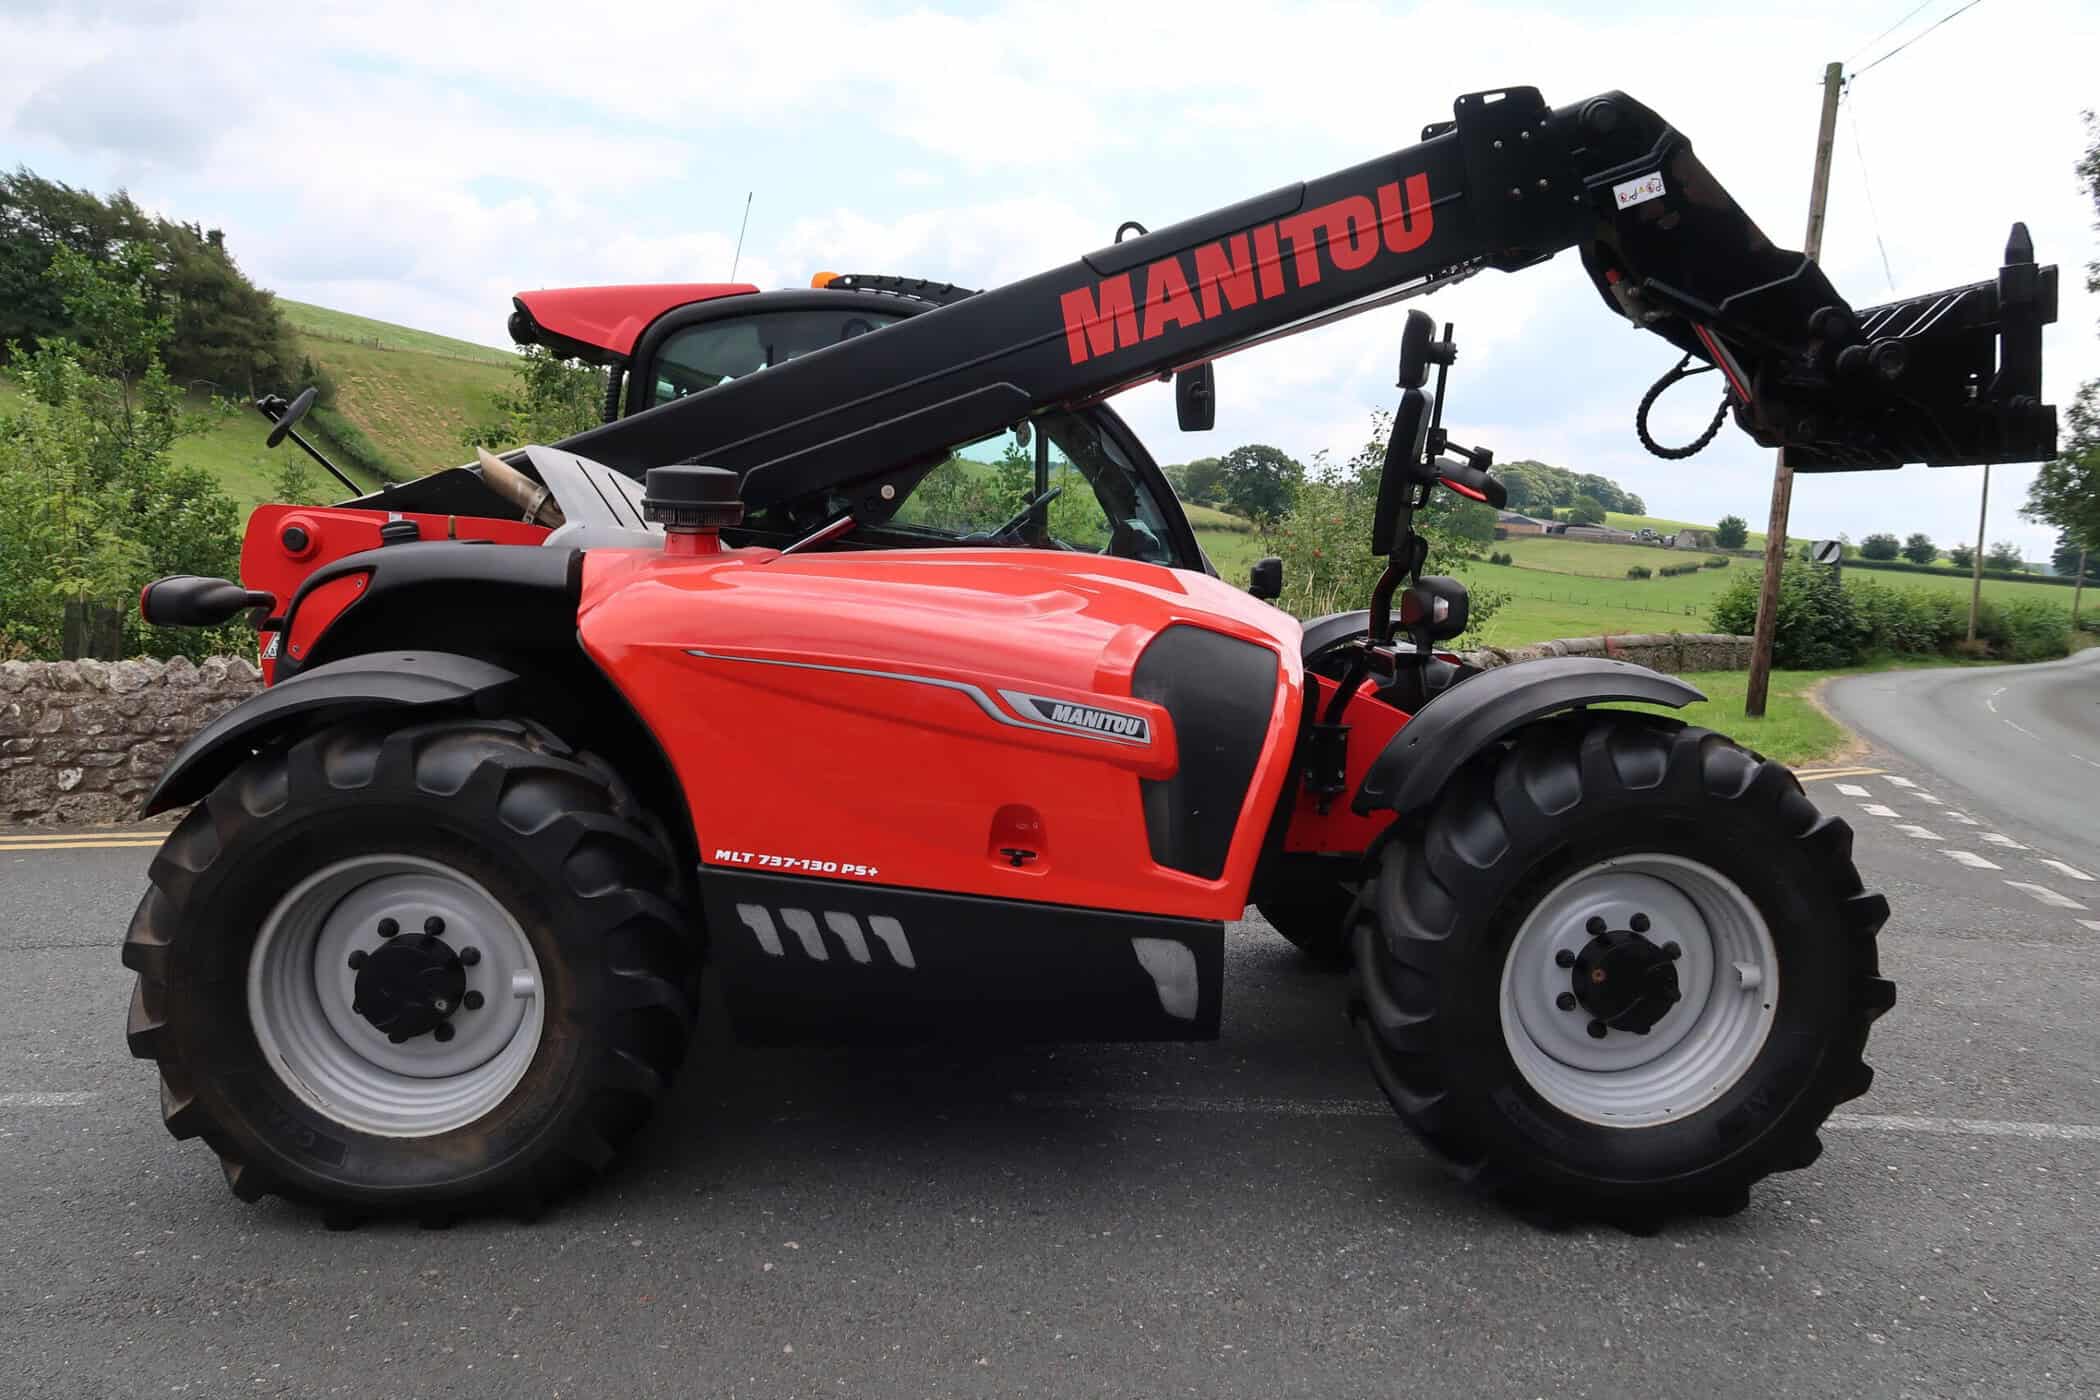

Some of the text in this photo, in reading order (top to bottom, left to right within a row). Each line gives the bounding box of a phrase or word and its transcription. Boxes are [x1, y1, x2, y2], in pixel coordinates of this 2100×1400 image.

[1060, 173, 1434, 365] MANITOU
[1052, 704, 1141, 736] MANITOU
[715, 849, 879, 878] MLT 737-130 PS+
